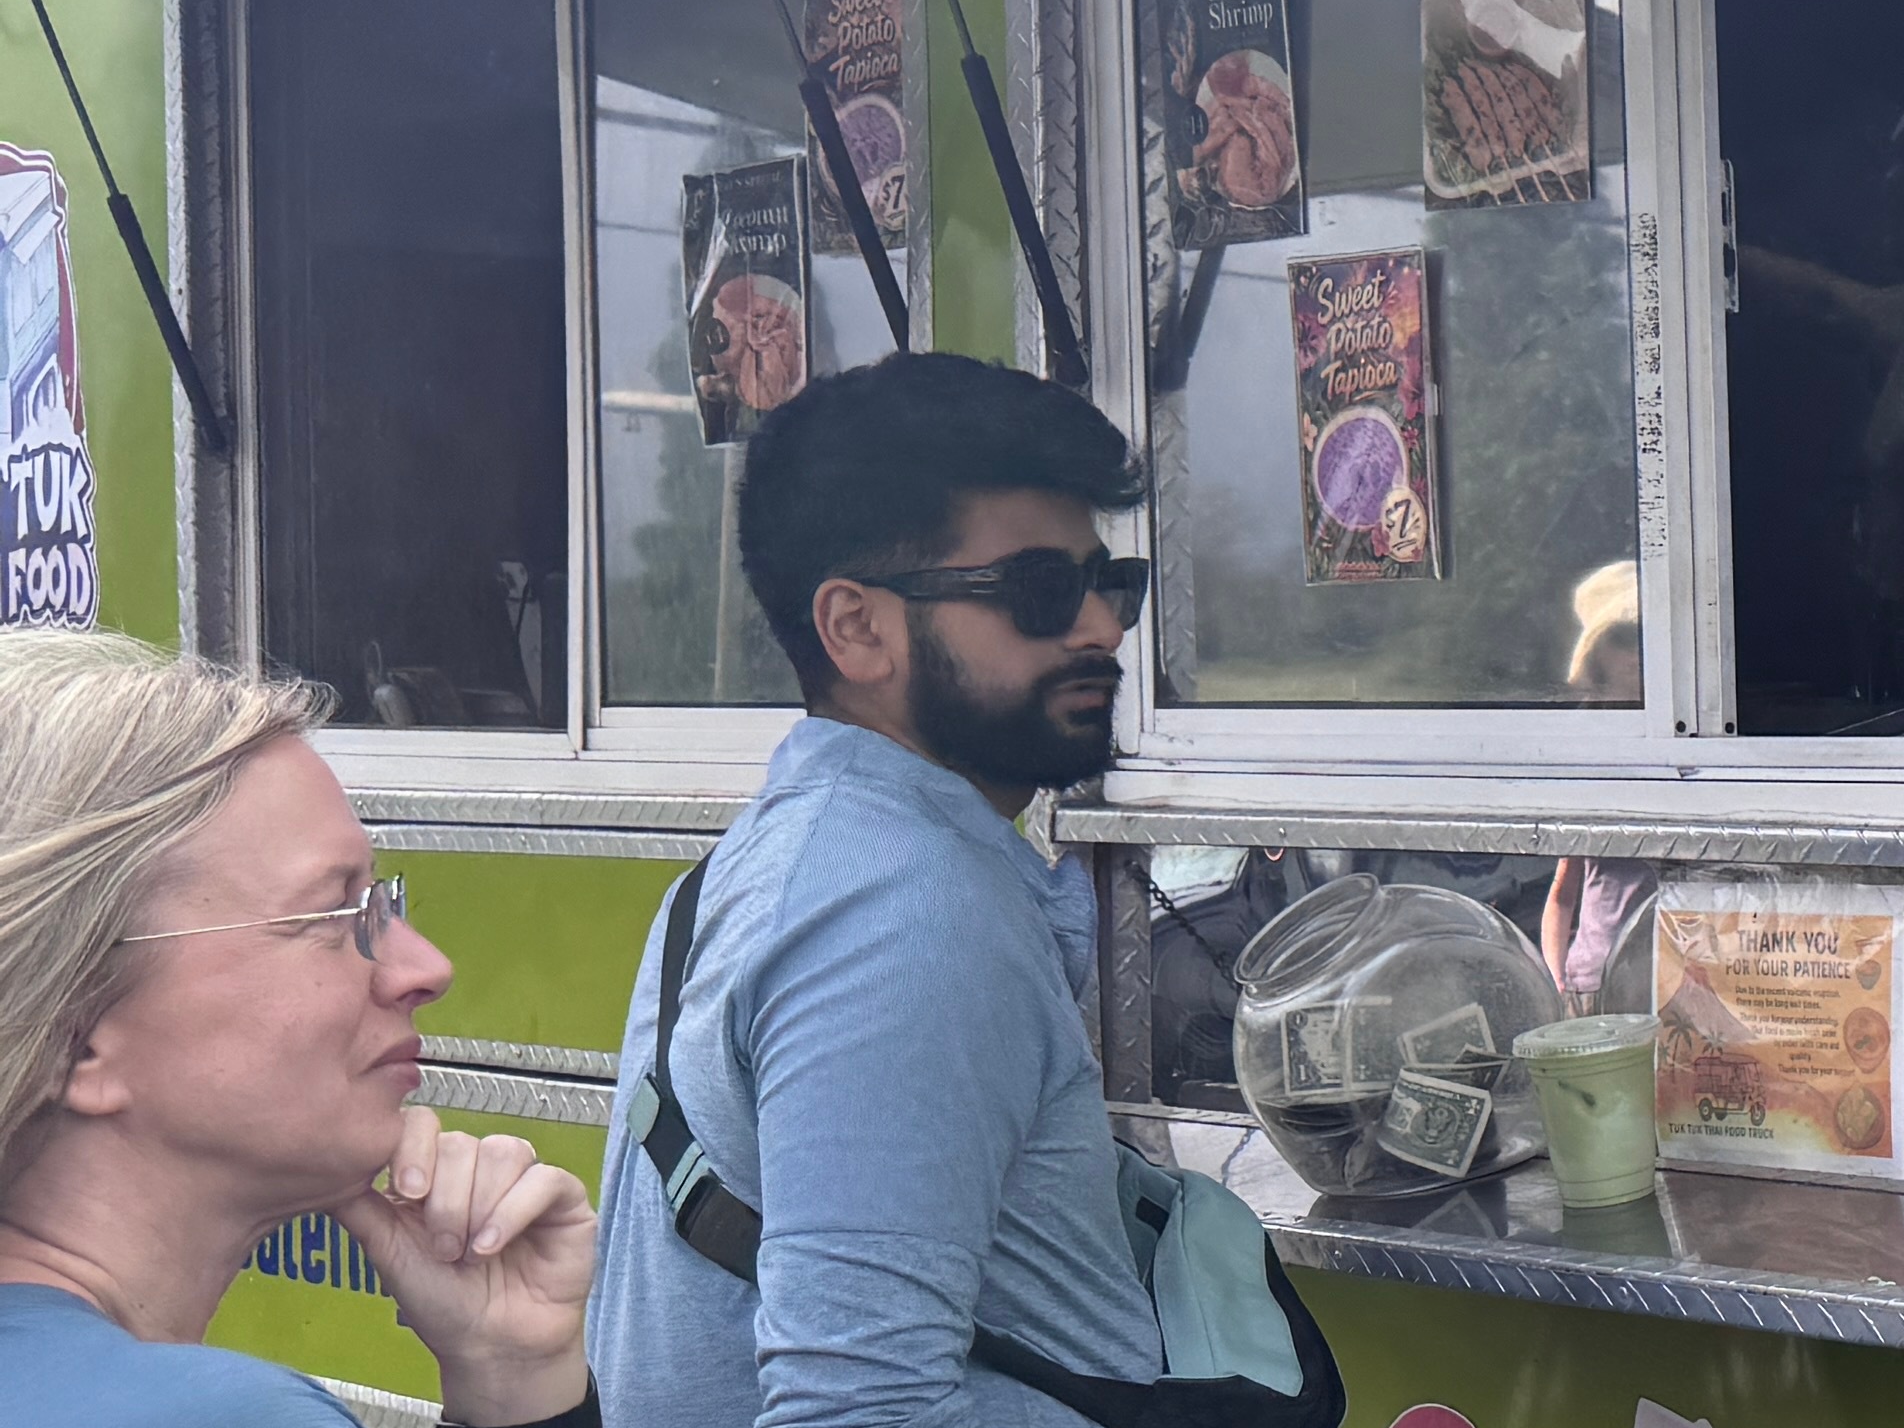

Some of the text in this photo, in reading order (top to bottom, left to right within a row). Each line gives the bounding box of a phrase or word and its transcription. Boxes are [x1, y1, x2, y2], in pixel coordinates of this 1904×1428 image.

[838, 13, 895, 55] Potato
[1209, 0, 1273, 29] Shrimp
[829, 51, 898, 92] Tapioca
[1317, 269, 1386, 325] Sweet
[1328, 316, 1392, 361] Potato
[1320, 357, 1397, 404] Tapioca
[10, 450, 88, 540] TUK
[1386, 499, 1411, 538] $7
[8, 543, 90, 618] FOOD
[1736, 930, 1839, 955] THANK YOU
[1725, 959, 1851, 979] FOR YOUR PATIENCE
[1669, 1123, 1686, 1134] TUK
[1705, 1126, 1723, 1136] THAI
[1749, 1128, 1774, 1139] TRUCK
